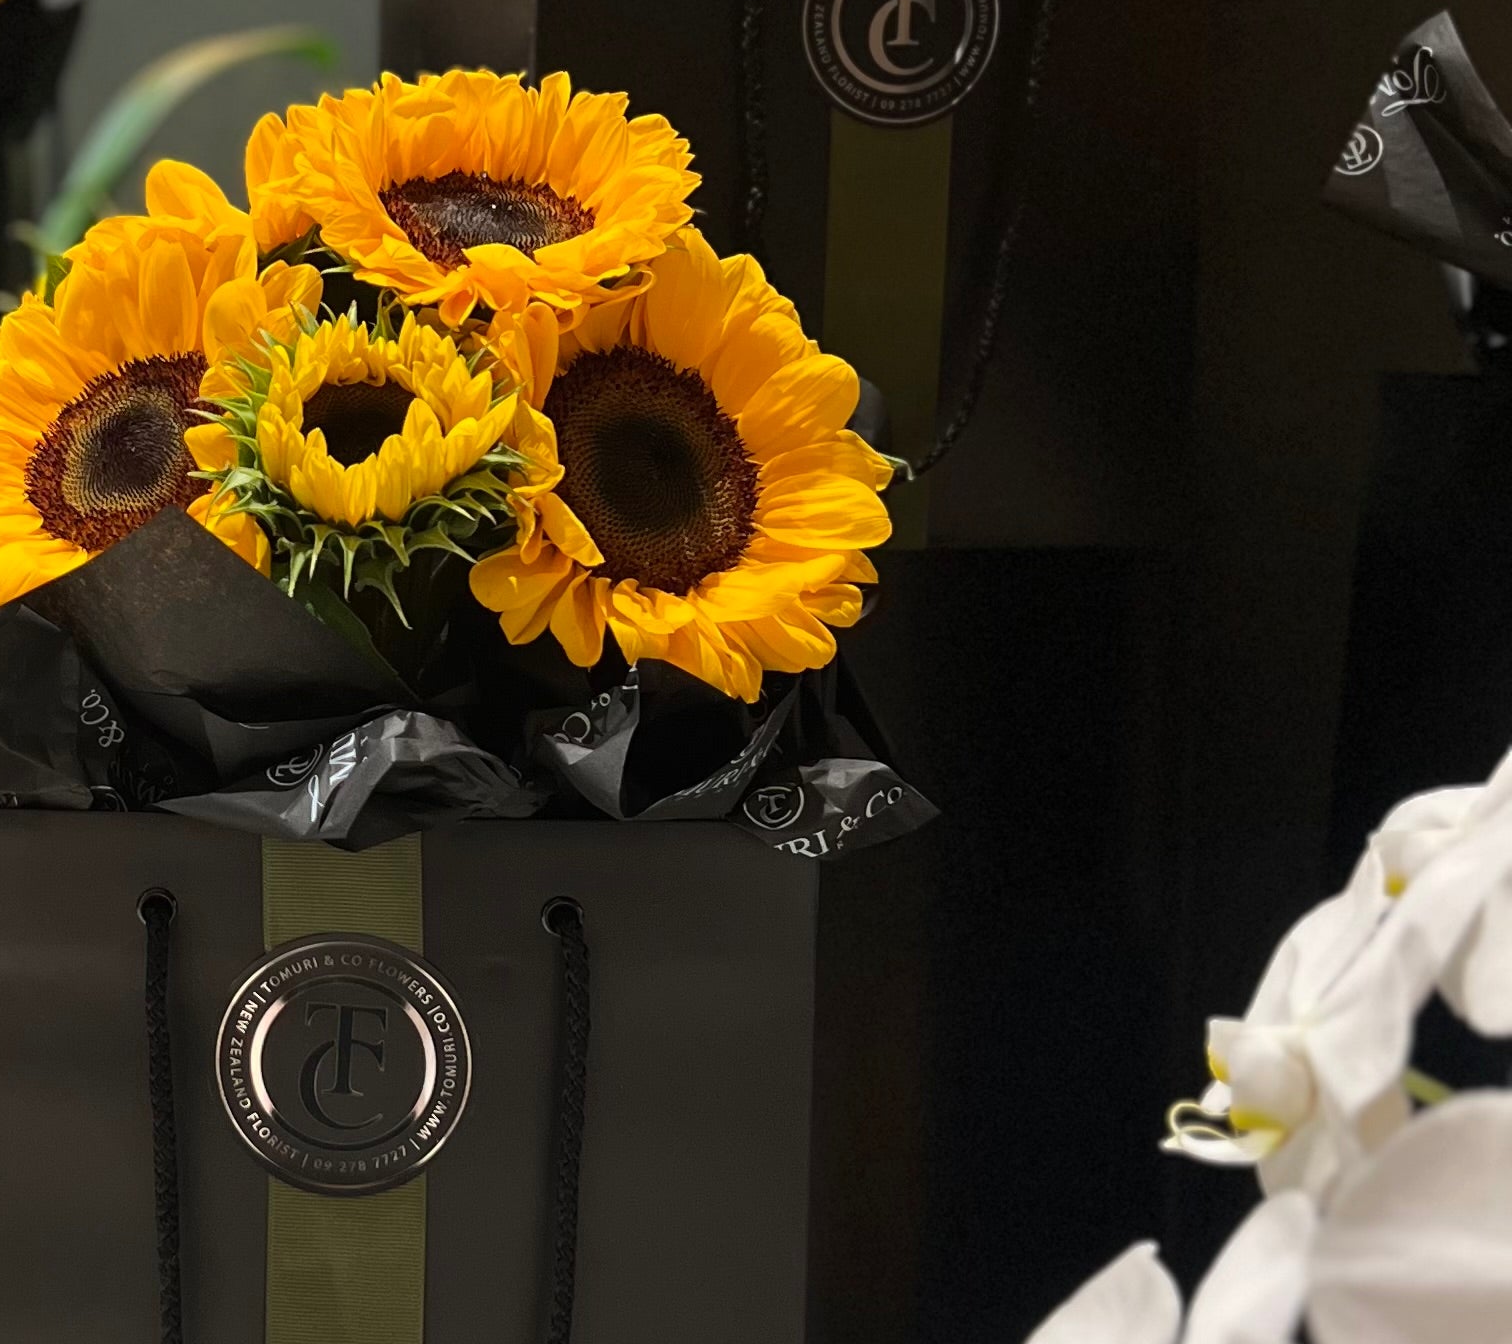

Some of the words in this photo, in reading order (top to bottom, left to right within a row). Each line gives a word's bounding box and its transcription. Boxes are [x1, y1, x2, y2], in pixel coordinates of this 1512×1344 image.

[260, 957, 319, 994] TOMURI
[324, 955, 335, 967] &
[340, 955, 363, 967] CO
[368, 959, 434, 1006] FLOWERS
[235, 998, 259, 1034] NEW
[229, 1036, 251, 1110] ZEALAND
[246, 1112, 299, 1160] FLORIST
[313, 1157, 333, 1171] 09
[339, 1159, 367, 1172] 278
[372, 1144, 408, 1170] 7727
